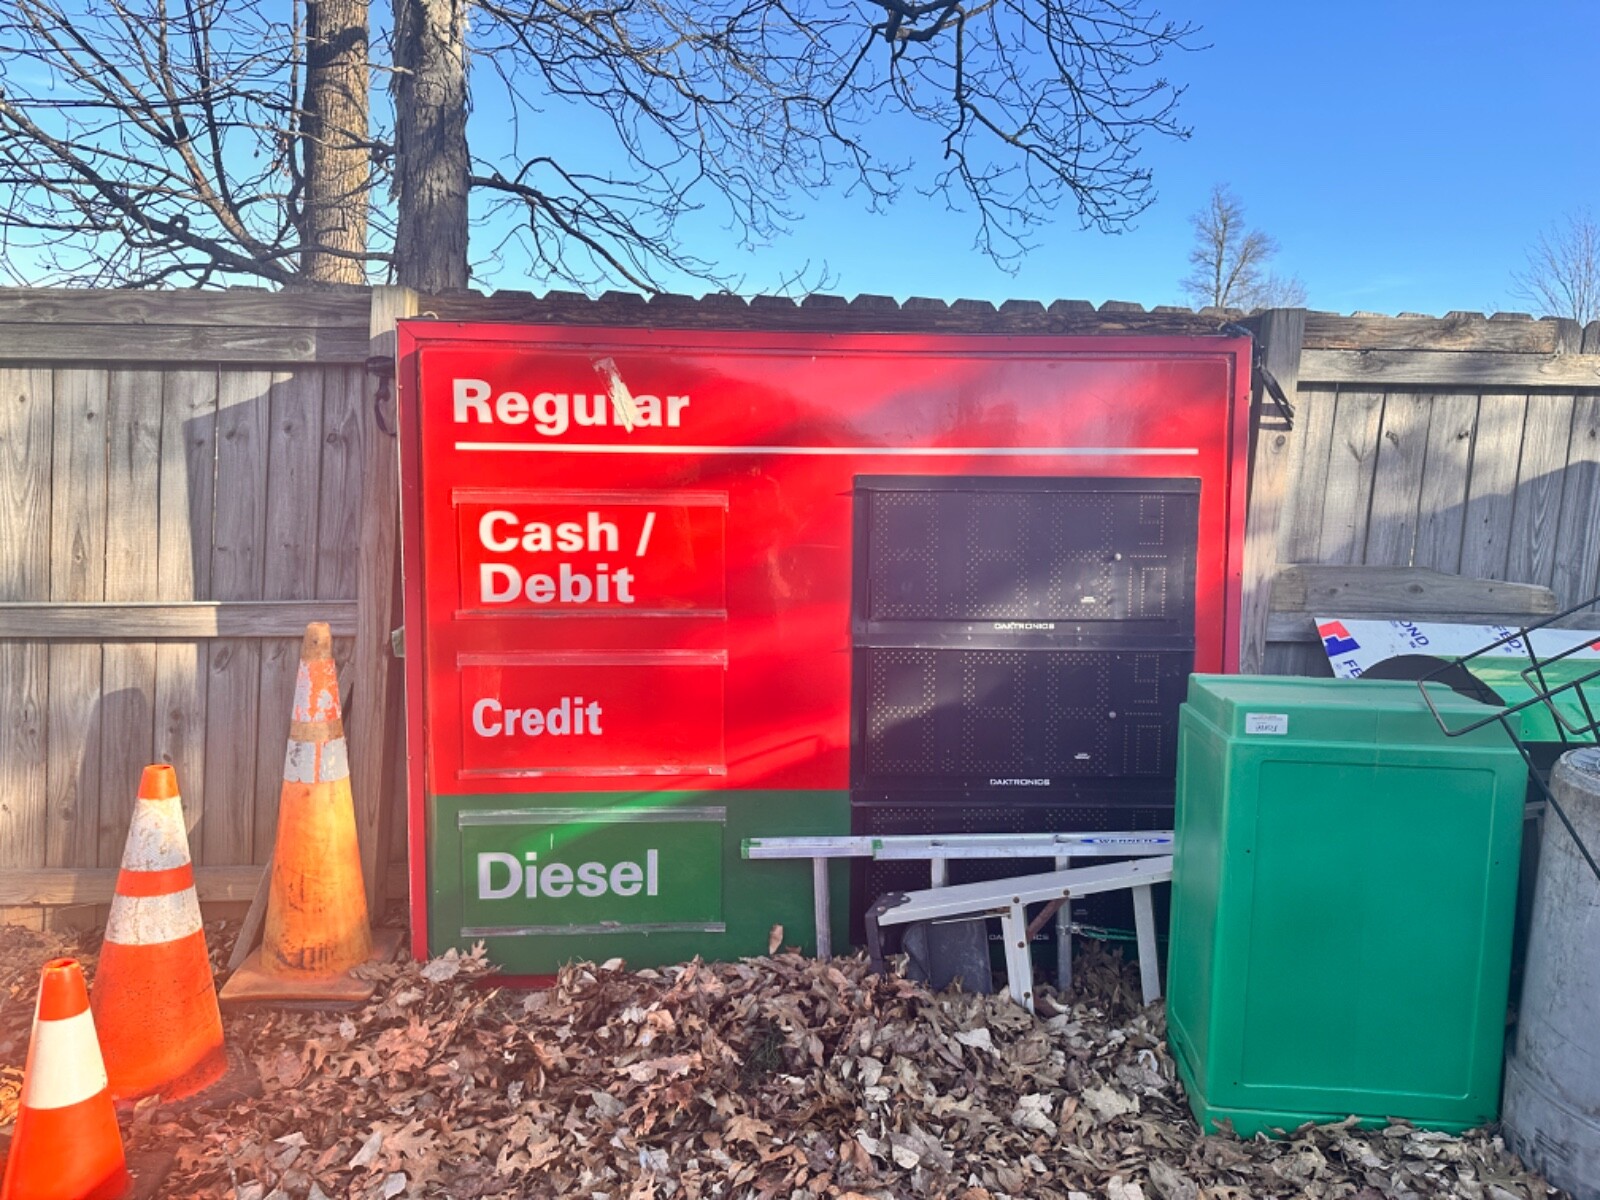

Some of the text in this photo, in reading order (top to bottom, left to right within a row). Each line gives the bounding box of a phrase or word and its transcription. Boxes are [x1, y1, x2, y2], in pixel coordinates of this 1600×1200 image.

[479, 511, 656, 556] Cash /
[480, 563, 635, 602] Debit
[994, 622, 1055, 630] DAKTRONICS
[473, 697, 602, 737] Credit
[990, 778, 1050, 786] DAKTRONICS
[478, 849, 658, 899] Diesel
